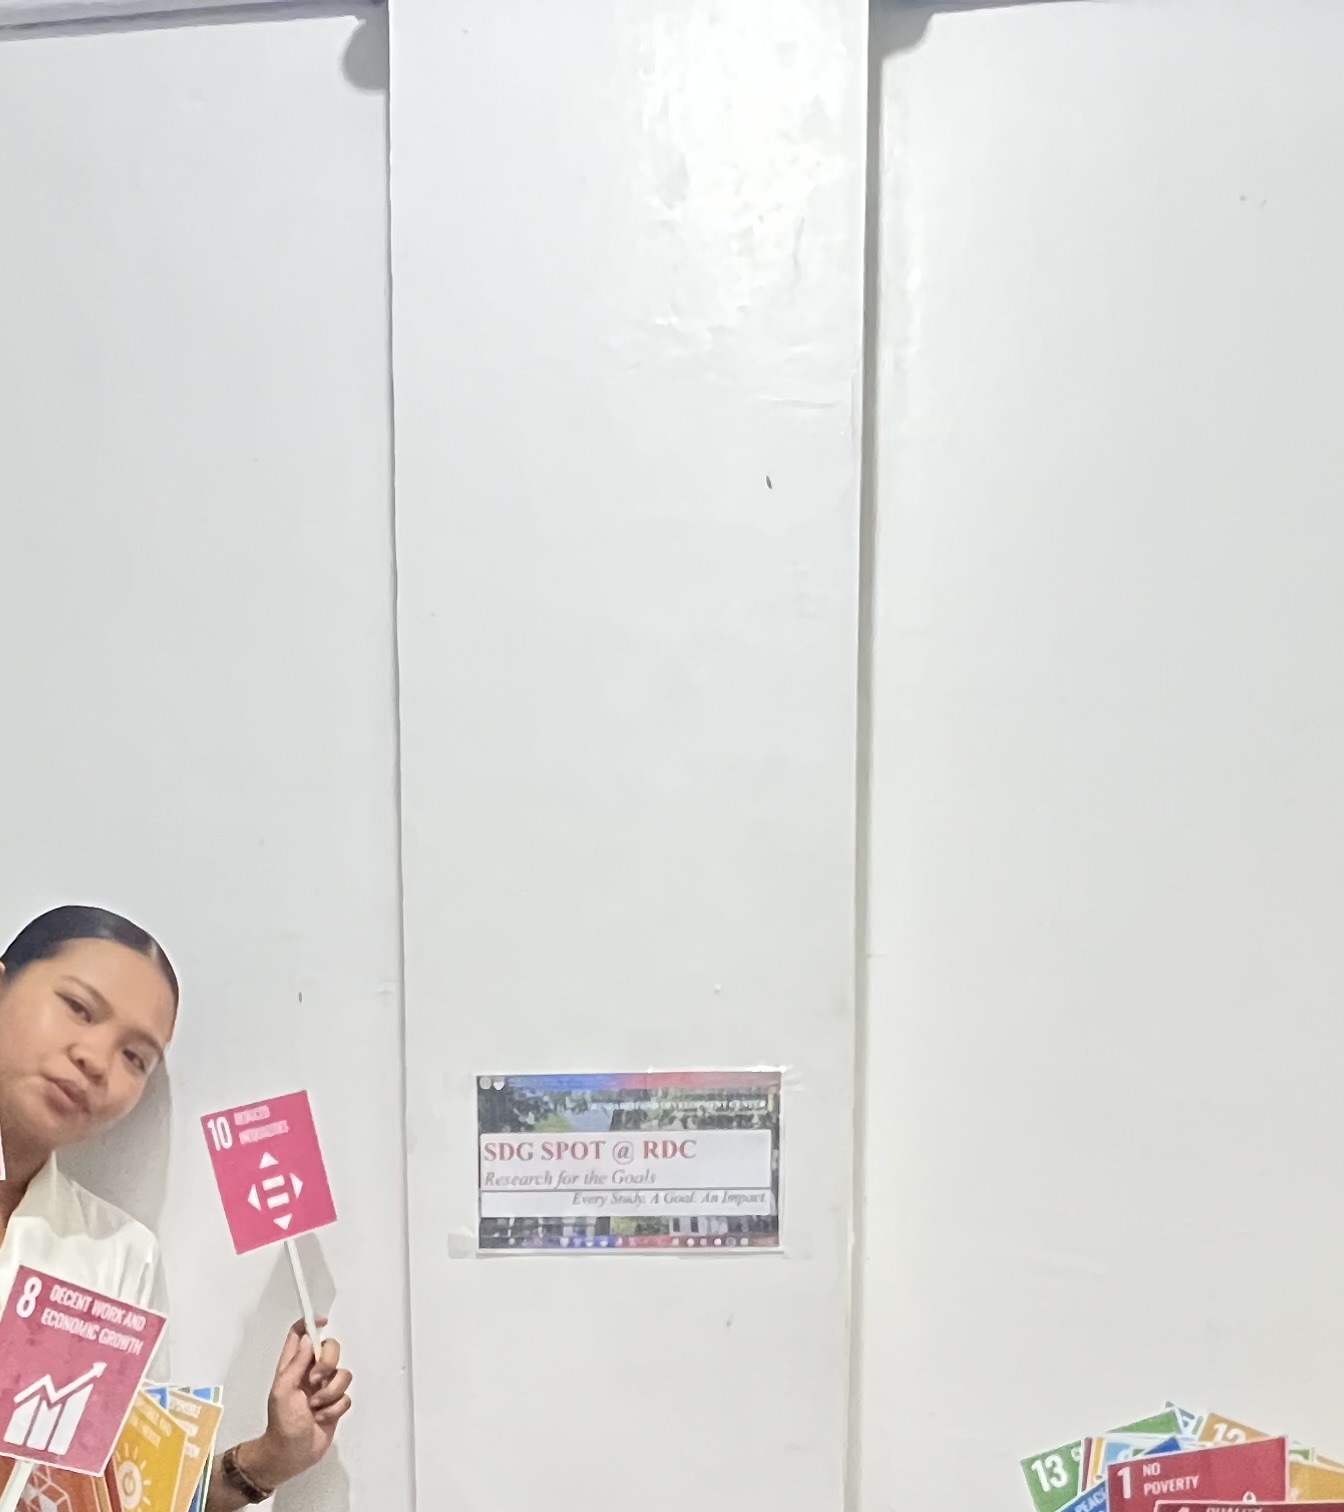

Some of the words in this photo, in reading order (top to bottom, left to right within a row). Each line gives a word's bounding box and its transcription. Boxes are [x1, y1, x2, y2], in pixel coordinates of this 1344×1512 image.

[207, 1116, 233, 1151] 10
[483, 1141, 534, 1162] SDG
[541, 1140, 606, 1161] SPOT
[612, 1140, 635, 1165] @
[643, 1139, 698, 1160] RDC
[484, 1170, 553, 1187] Research
[553, 1170, 578, 1190] for
[584, 1169, 608, 1185] the
[611, 1168, 656, 1185] Goals
[572, 1192, 607, 1207] Every
[650, 1192, 660, 1205] A
[701, 1192, 719, 1204] An
[16, 1276, 42, 1318] 8
[49, 1284, 92, 1313] DECENT
[91, 1299, 124, 1324] WORK
[123, 1313, 146, 1332] AND
[41, 1308, 100, 1341] ECONOMIC
[99, 1326, 144, 1357] GROWTH
[1031, 1456, 1068, 1493] 13
[1117, 1467, 1132, 1499] 1
[1143, 1462, 1161, 1478] NO
[1143, 1475, 1200, 1496] POVERTY
